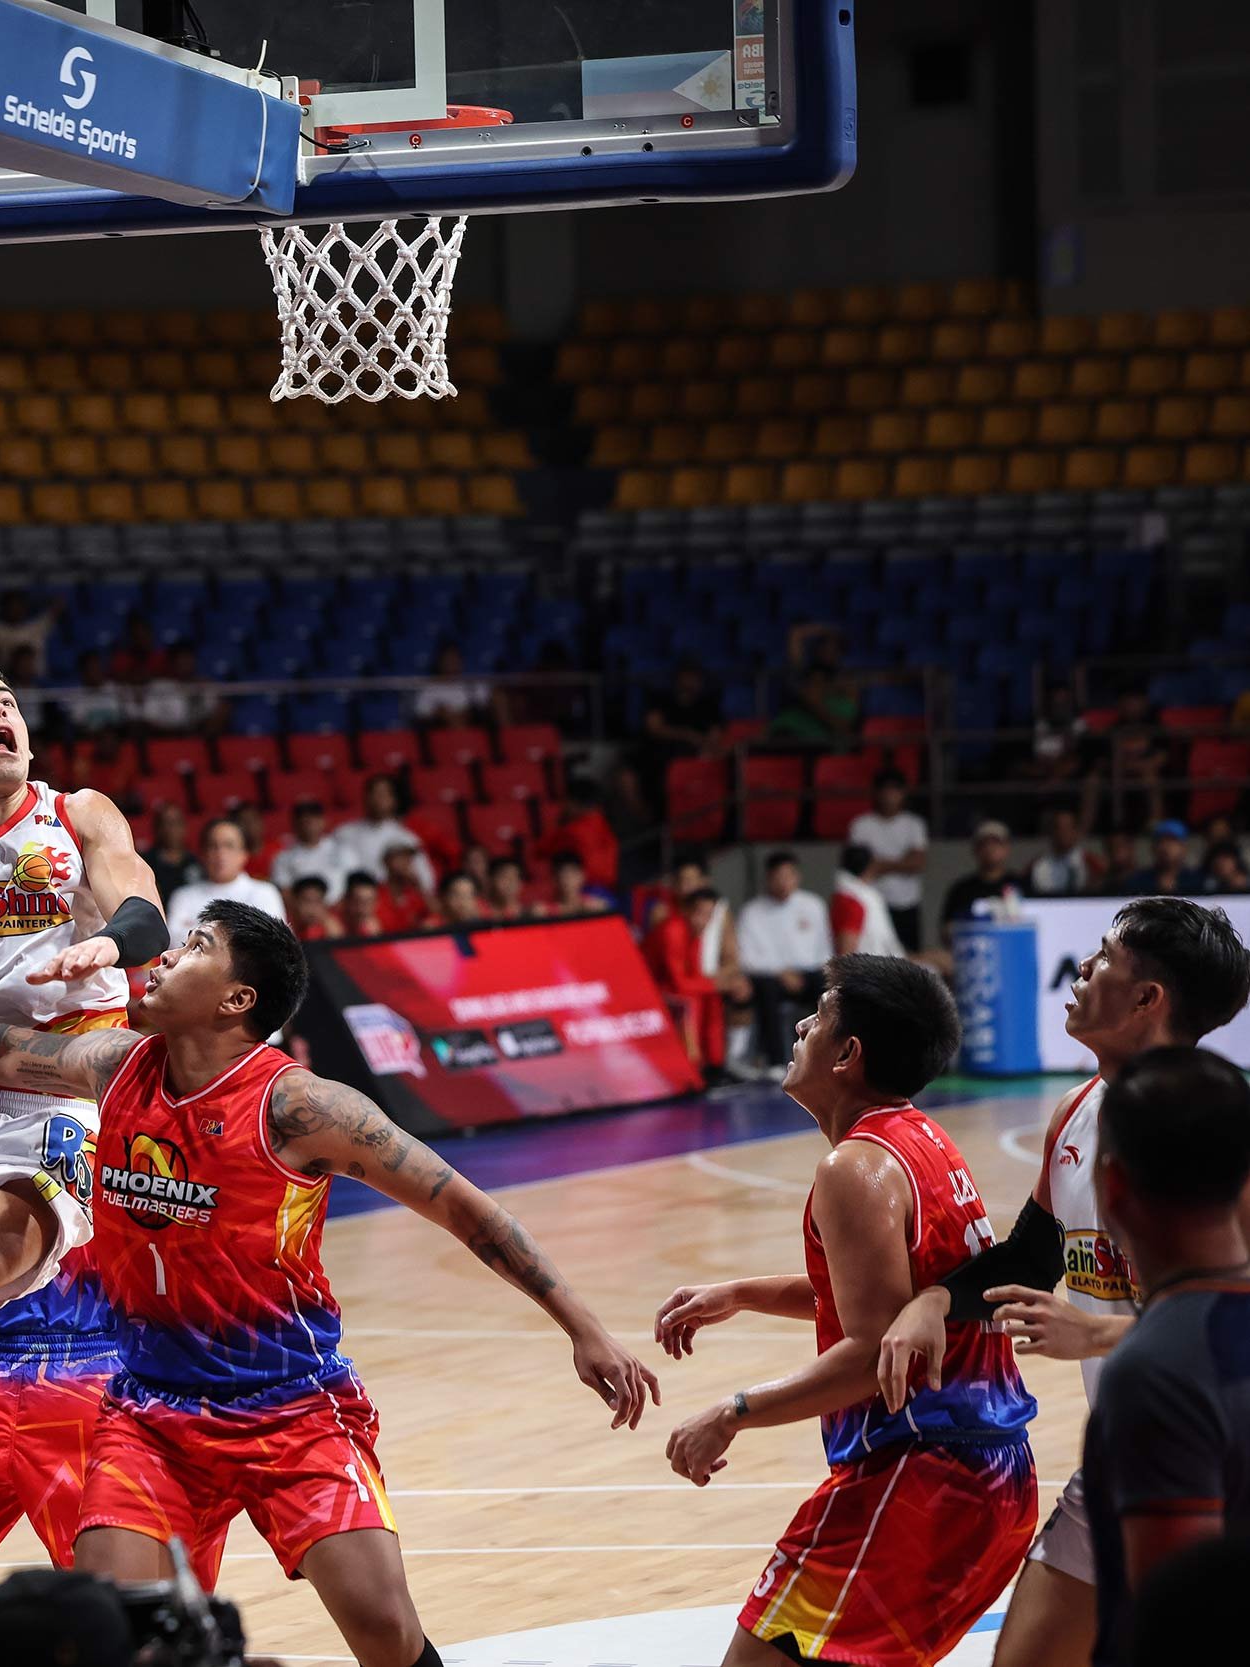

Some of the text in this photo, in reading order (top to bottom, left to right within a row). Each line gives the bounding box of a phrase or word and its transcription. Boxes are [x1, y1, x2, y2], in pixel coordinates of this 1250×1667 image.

[3, 95, 137, 159] Schelde Sports
[101, 1165, 218, 1207] PHOENIX
[149, 1243, 167, 1296] 1
